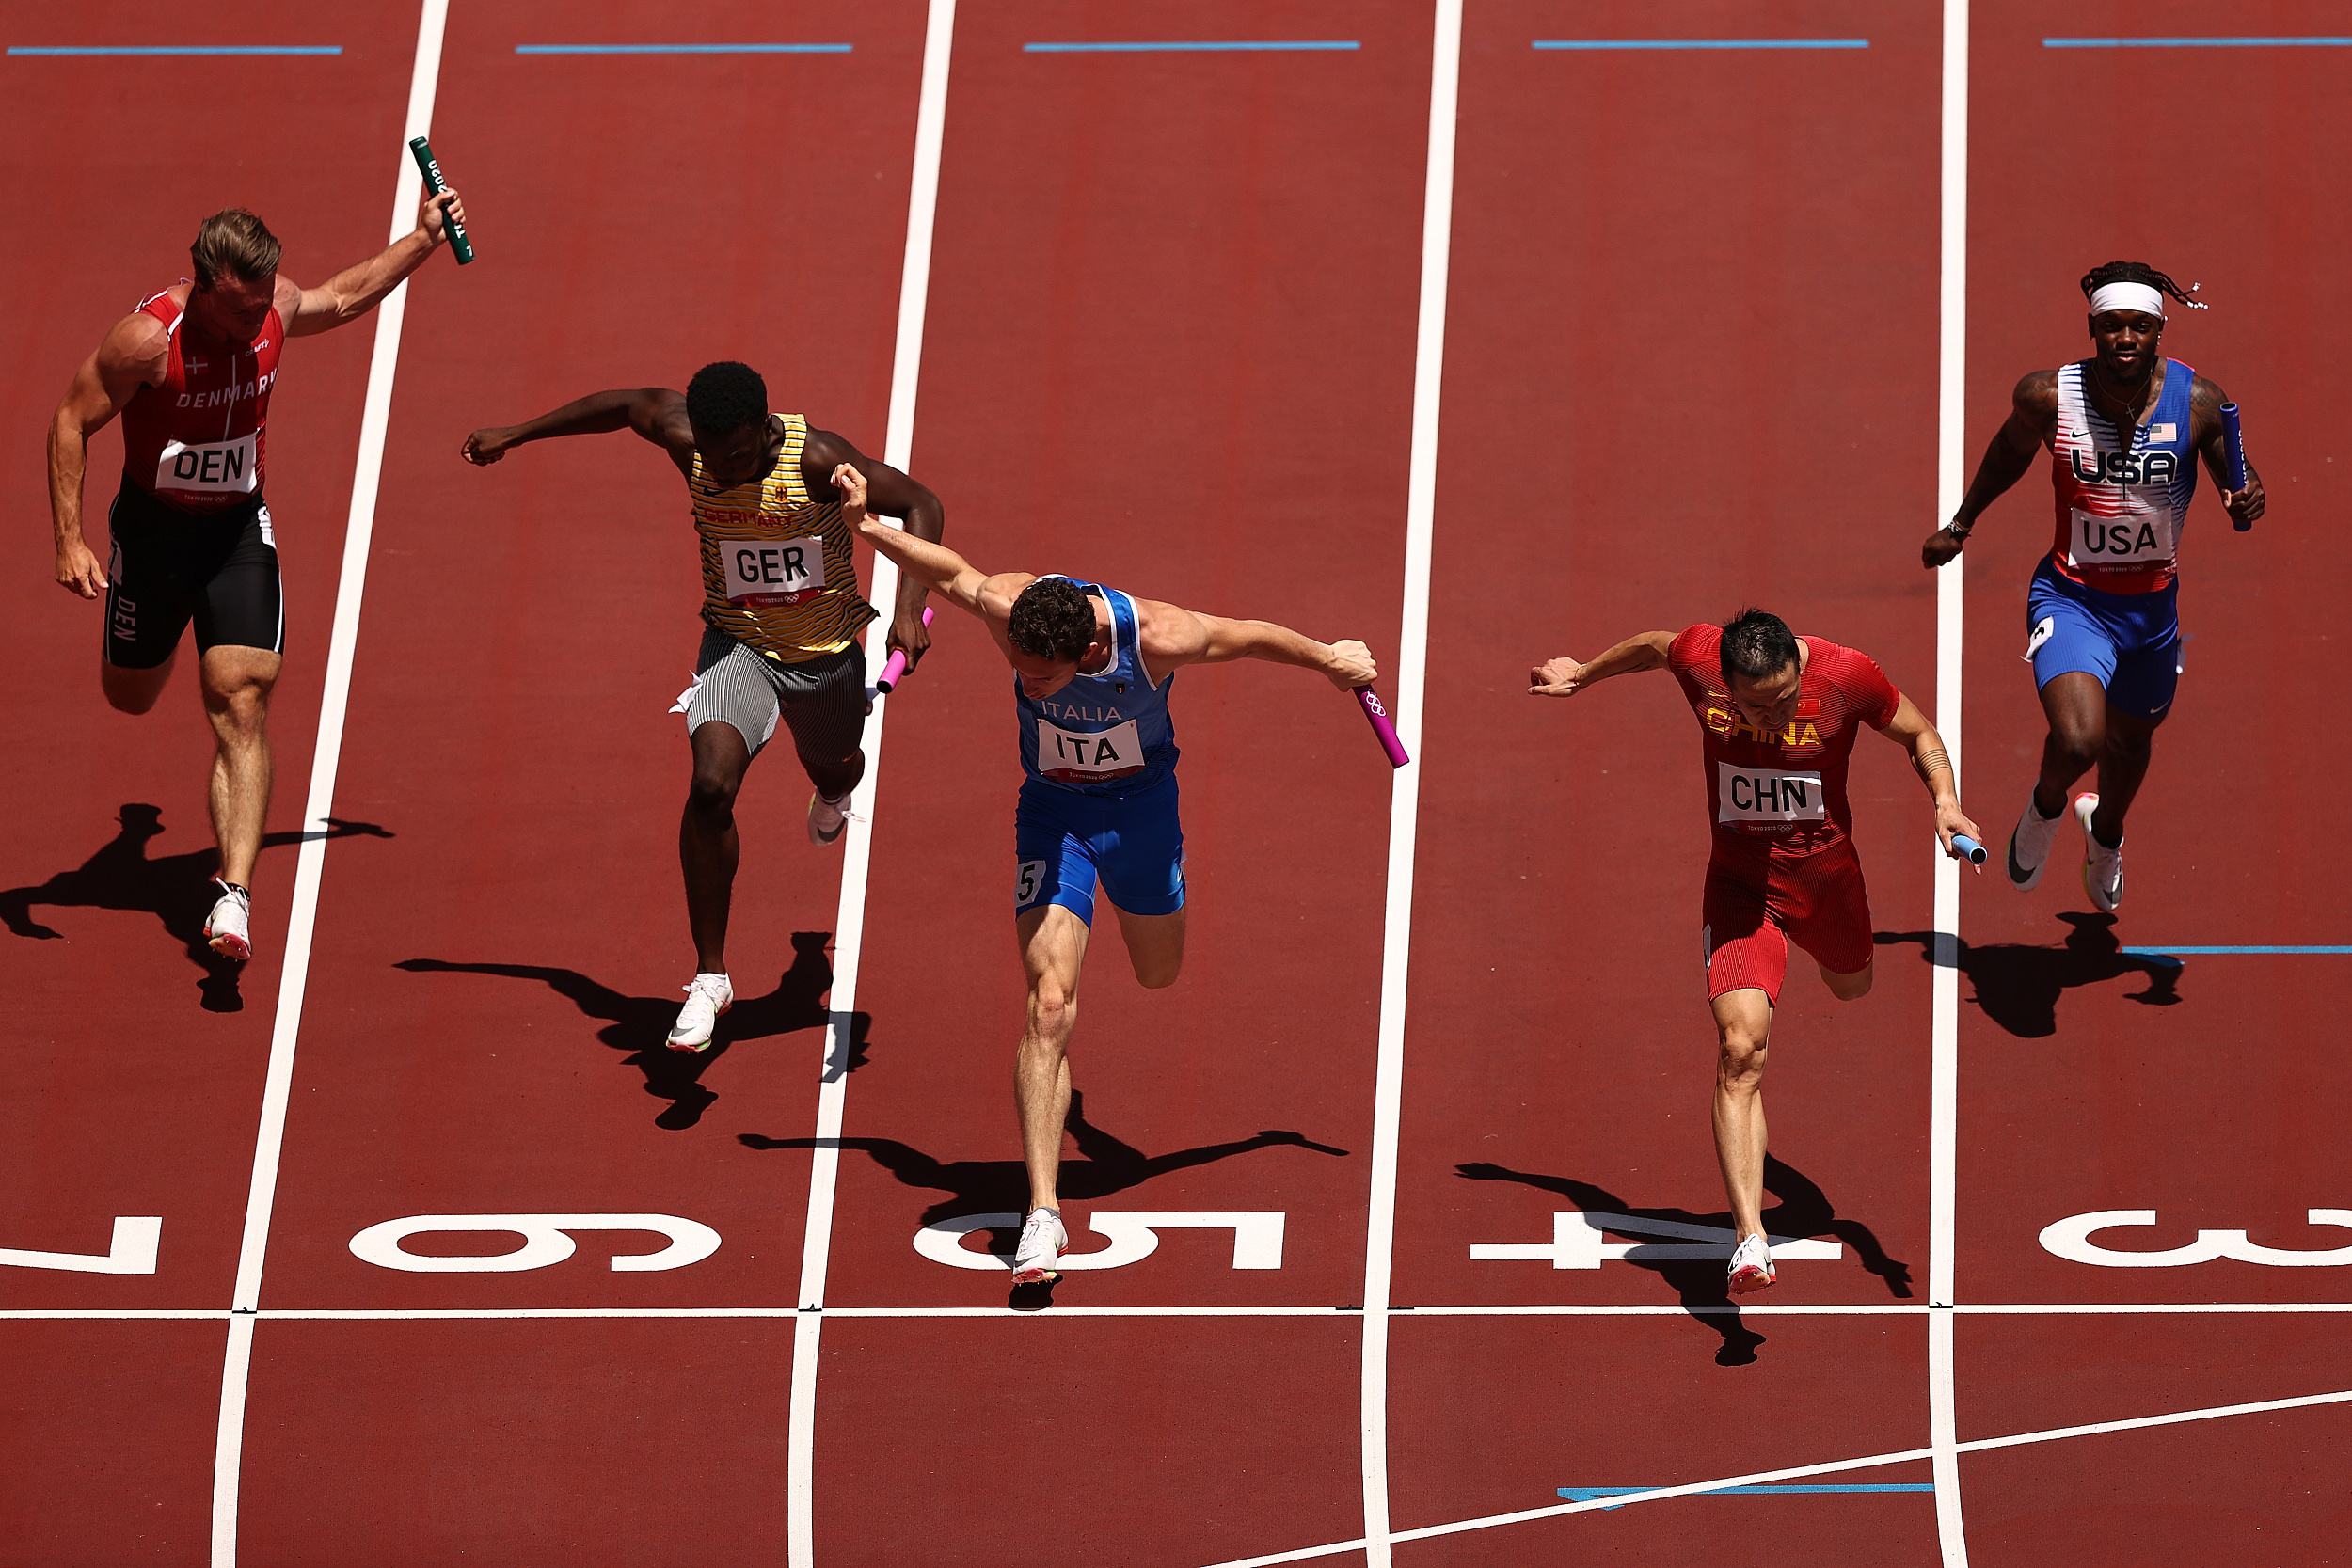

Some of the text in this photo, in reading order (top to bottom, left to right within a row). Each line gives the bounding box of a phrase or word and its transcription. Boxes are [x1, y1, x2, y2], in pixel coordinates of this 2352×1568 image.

[176, 367, 278, 408] DENMARK
[174, 445, 245, 483] DEN
[2070, 448, 2178, 485] USA
[2083, 520, 2158, 555] USA
[736, 546, 809, 584] GER
[114, 595, 136, 641] DEN
[1041, 701, 1122, 721] ITALIA
[1707, 707, 1823, 746] CHINA
[1056, 733, 1120, 766] ITA
[1731, 774, 1808, 812] CHN
[1017, 863, 1036, 901] 5
[348, 1213, 723, 1273] 6
[913, 1212, 1285, 1270] 5
[1470, 1212, 1842, 1270] 4
[2038, 1208, 2352, 1268] 3
